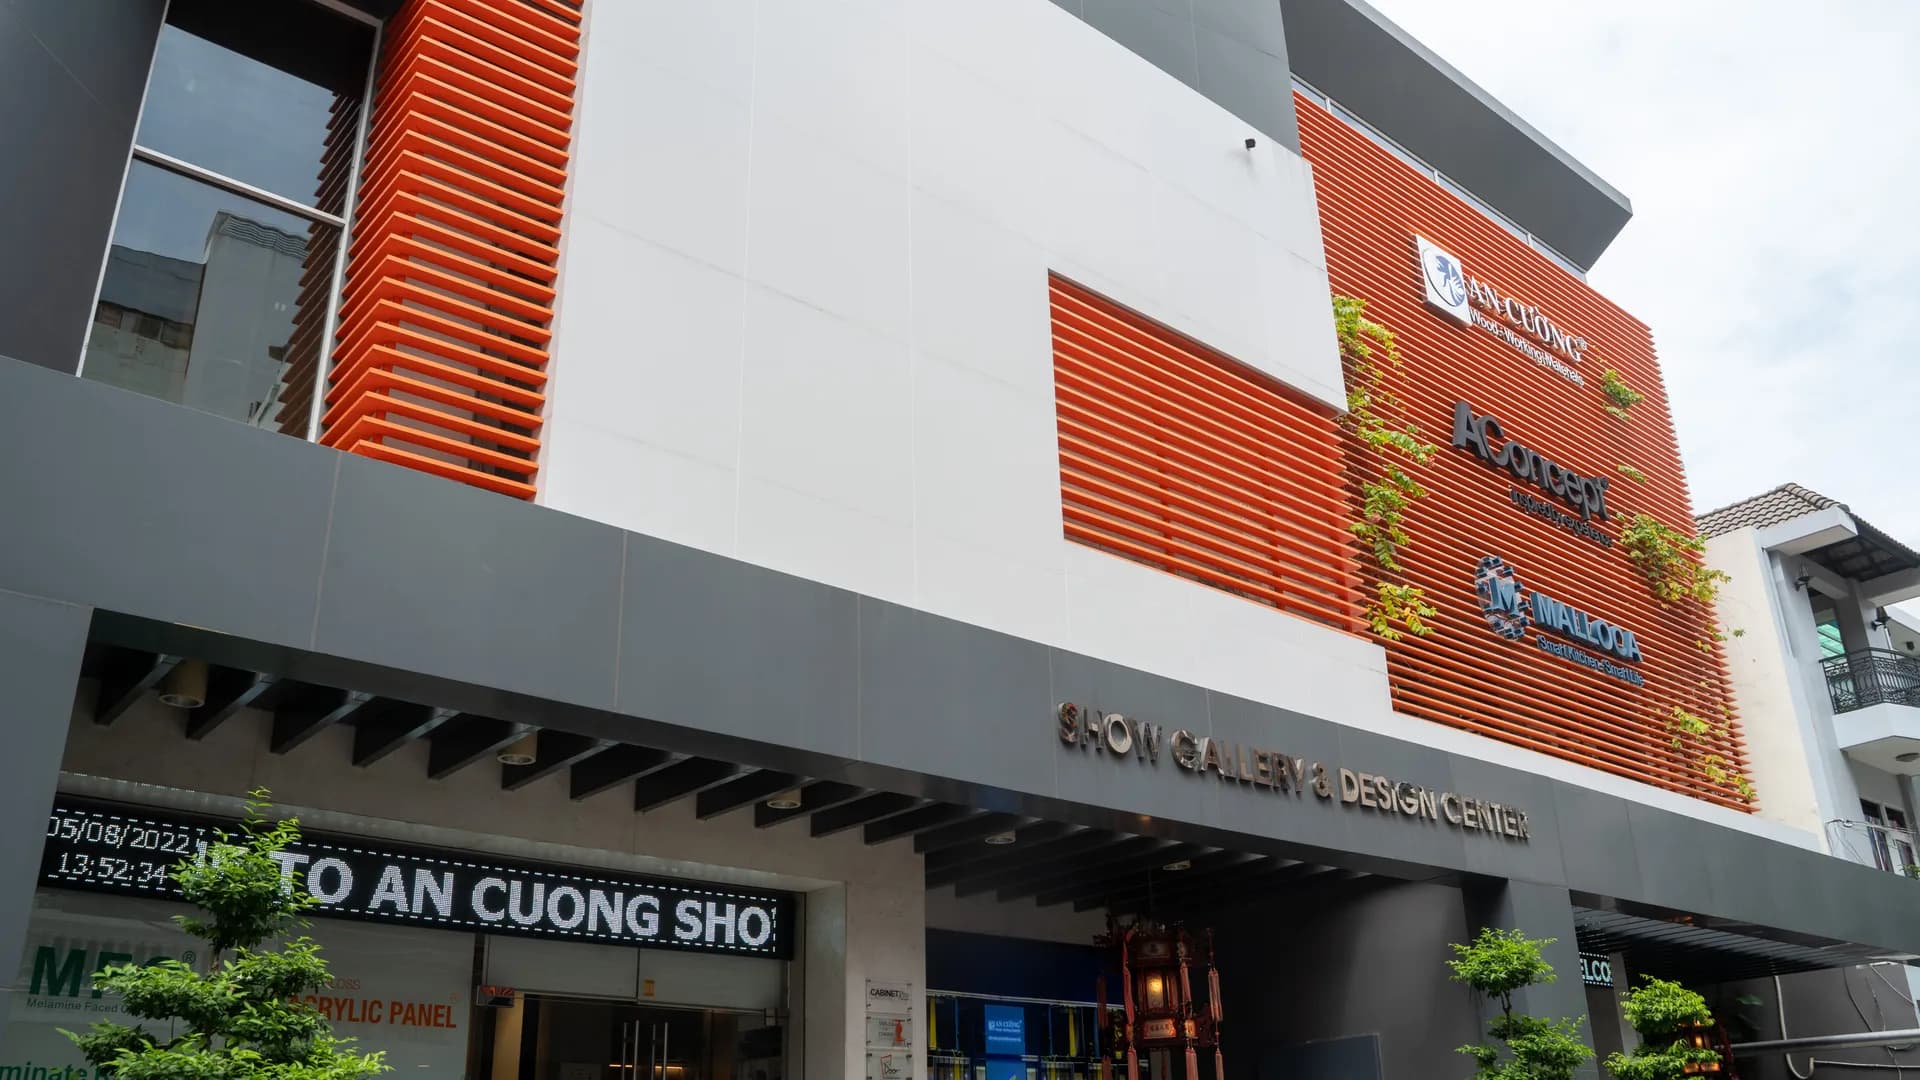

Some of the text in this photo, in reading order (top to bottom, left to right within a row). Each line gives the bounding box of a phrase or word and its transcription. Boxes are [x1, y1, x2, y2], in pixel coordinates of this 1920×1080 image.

[1467, 275, 1501, 314] AN
[1530, 591, 1643, 662] MALLOCA
[1057, 701, 1532, 840] SHOW GALLERY & DESIGN CENTER
[58, 852, 168, 885] 13:52:34
[269, 850, 353, 905] TO
[369, 865, 454, 917] AN
[472, 877, 660, 937] CUONG
[674, 899, 772, 946] SHO
[26, 997, 81, 1010] Melamine
[84, 1001, 118, 1013] Faced
[389, 1000, 457, 1029] PANEL
